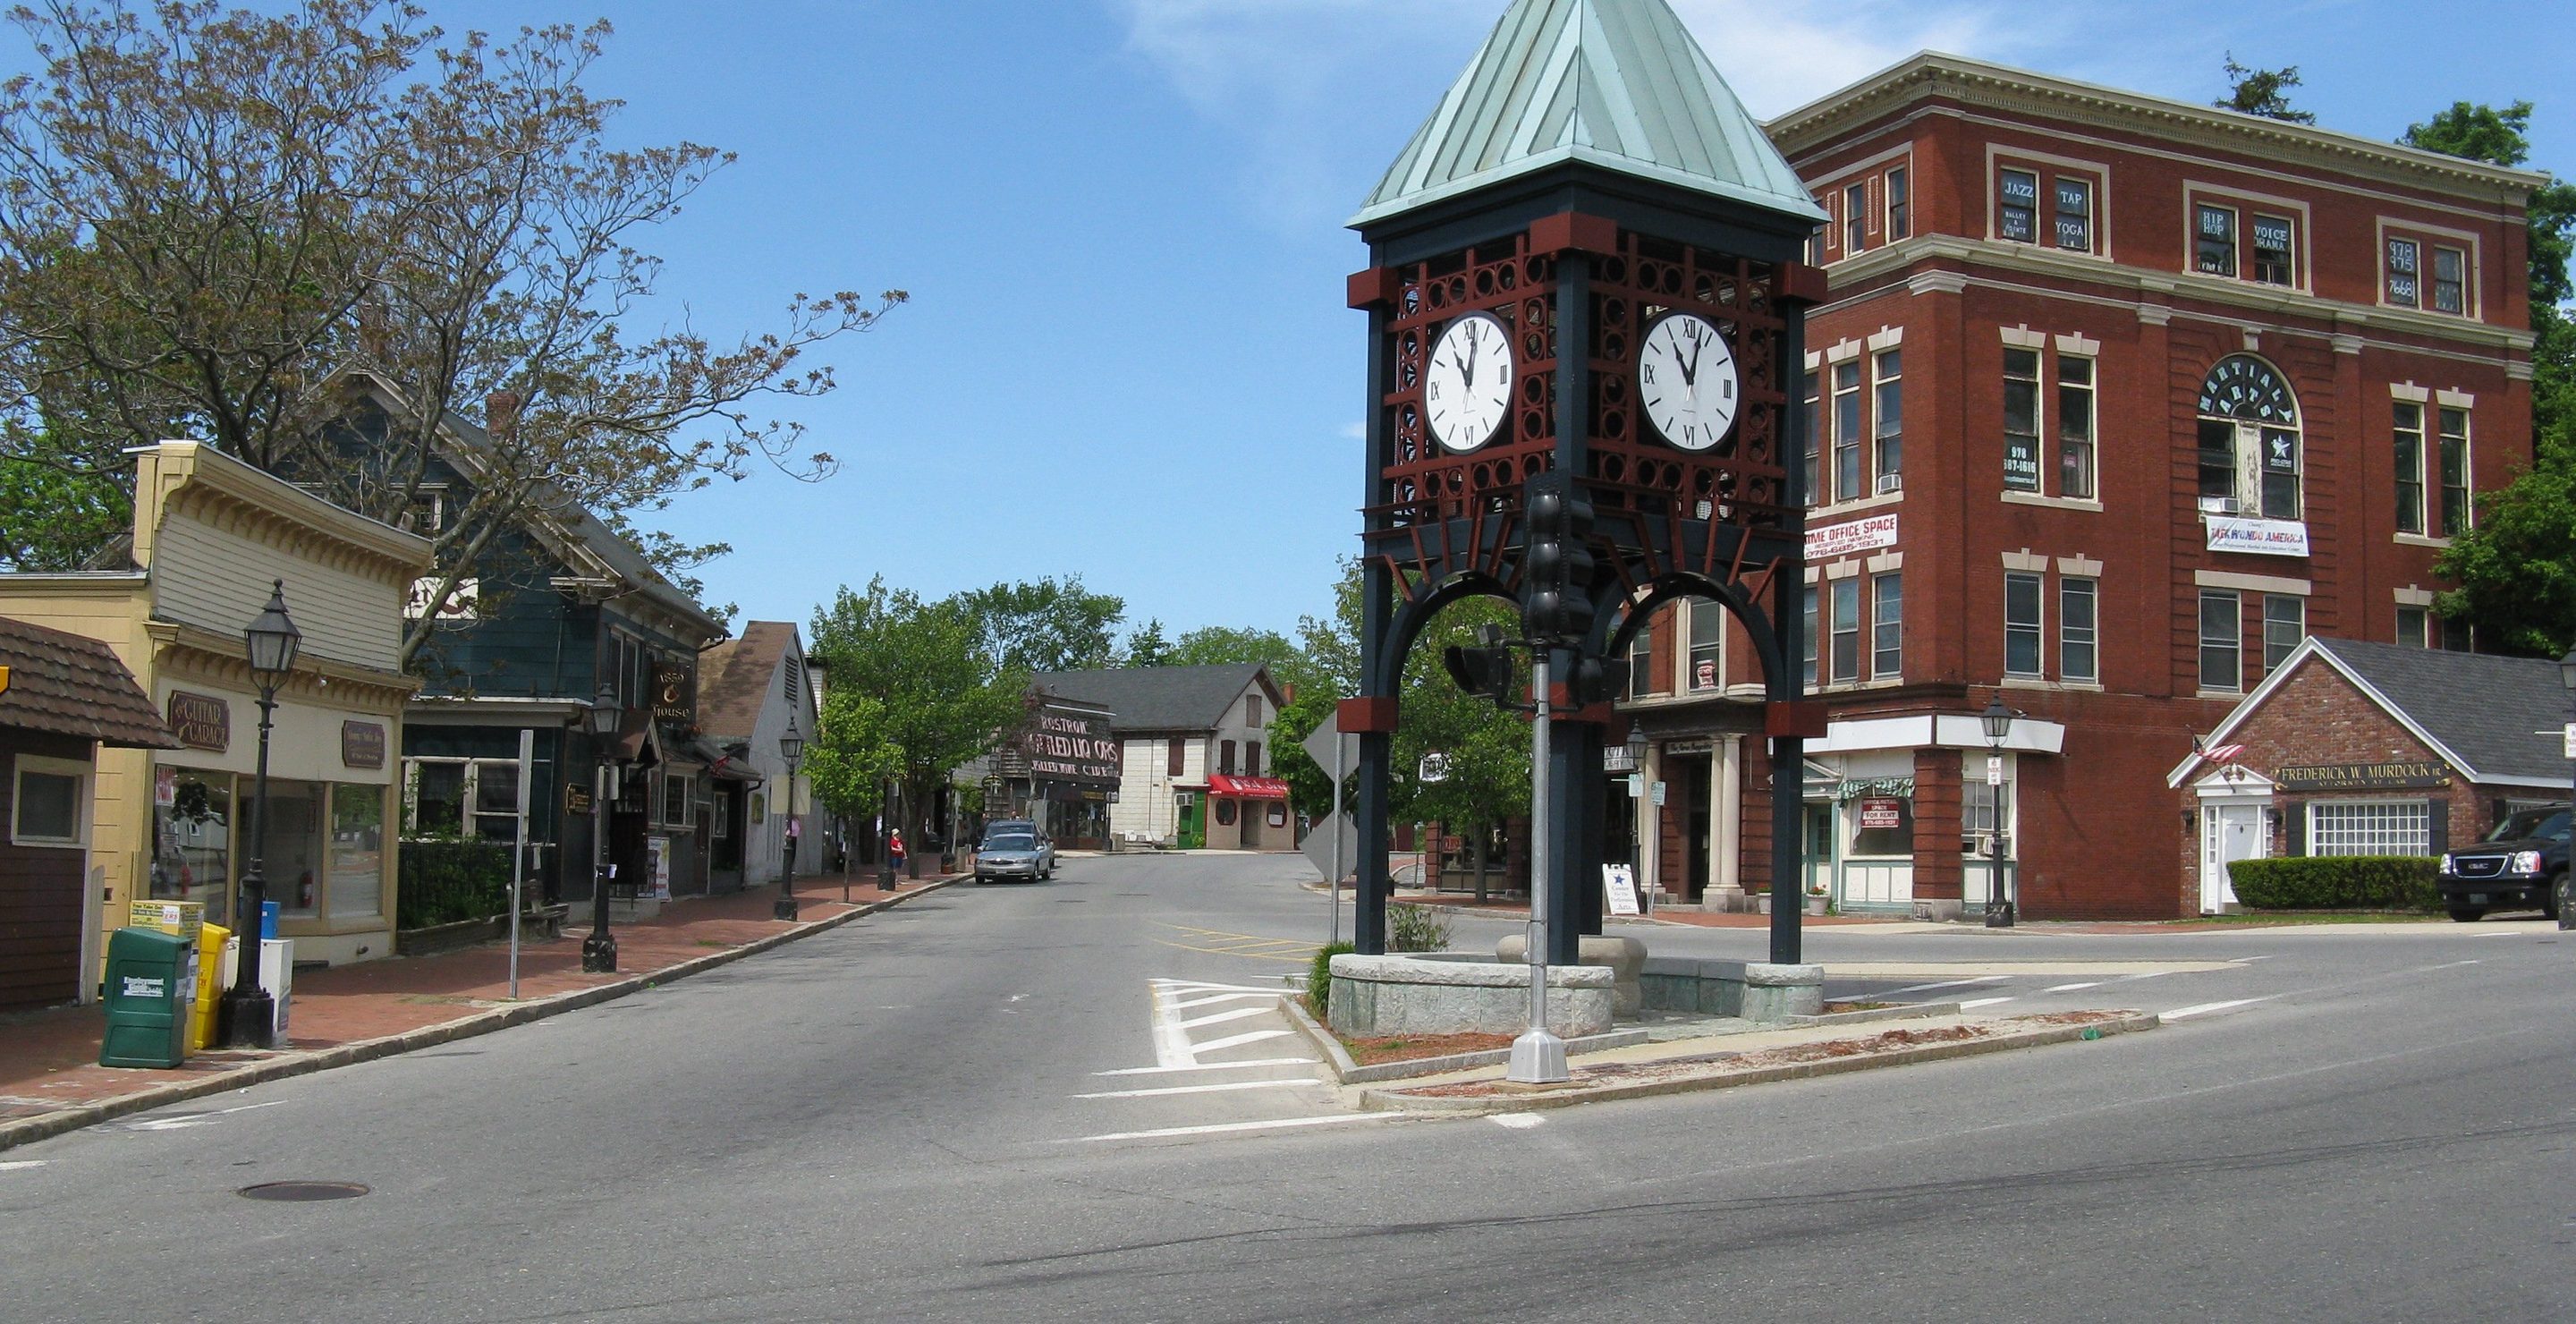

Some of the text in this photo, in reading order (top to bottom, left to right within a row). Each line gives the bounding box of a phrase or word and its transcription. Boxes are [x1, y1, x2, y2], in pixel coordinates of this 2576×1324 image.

[2004, 182, 2034, 198] JAZZ
[2060, 191, 2082, 204] TAP
[2005, 211, 2026, 220] BALLET
[2203, 211, 2224, 224] HIP
[2055, 221, 2084, 237] YOGA
[2203, 223, 2224, 235] HOP
[2254, 225, 2287, 242] VOICE
[2389, 241, 2412, 257] 978
[2389, 255, 2413, 271] 975
[2389, 279, 2412, 296] 7668
[1682, 318, 1696, 339] XII
[1500, 365, 1508, 385] III
[1644, 364, 1655, 385] IX
[1431, 380, 1440, 401] IX
[1723, 379, 1732, 400] III
[2199, 361, 2282, 412] MARTIAL
[2219, 385, 2271, 418] ARTS
[1464, 426, 1474, 446] VI
[1683, 425, 1695, 446] VI
[2012, 446, 2027, 459] 978
[1829, 523, 1860, 540] OFFICE
[1863, 517, 1895, 534] SPACE
[2265, 531, 2304, 544] AMERICA
[184, 698, 221, 725] GUITAR
[2282, 766, 2346, 781] FREDERICK
[2368, 763, 2429, 778] MURDOCK
